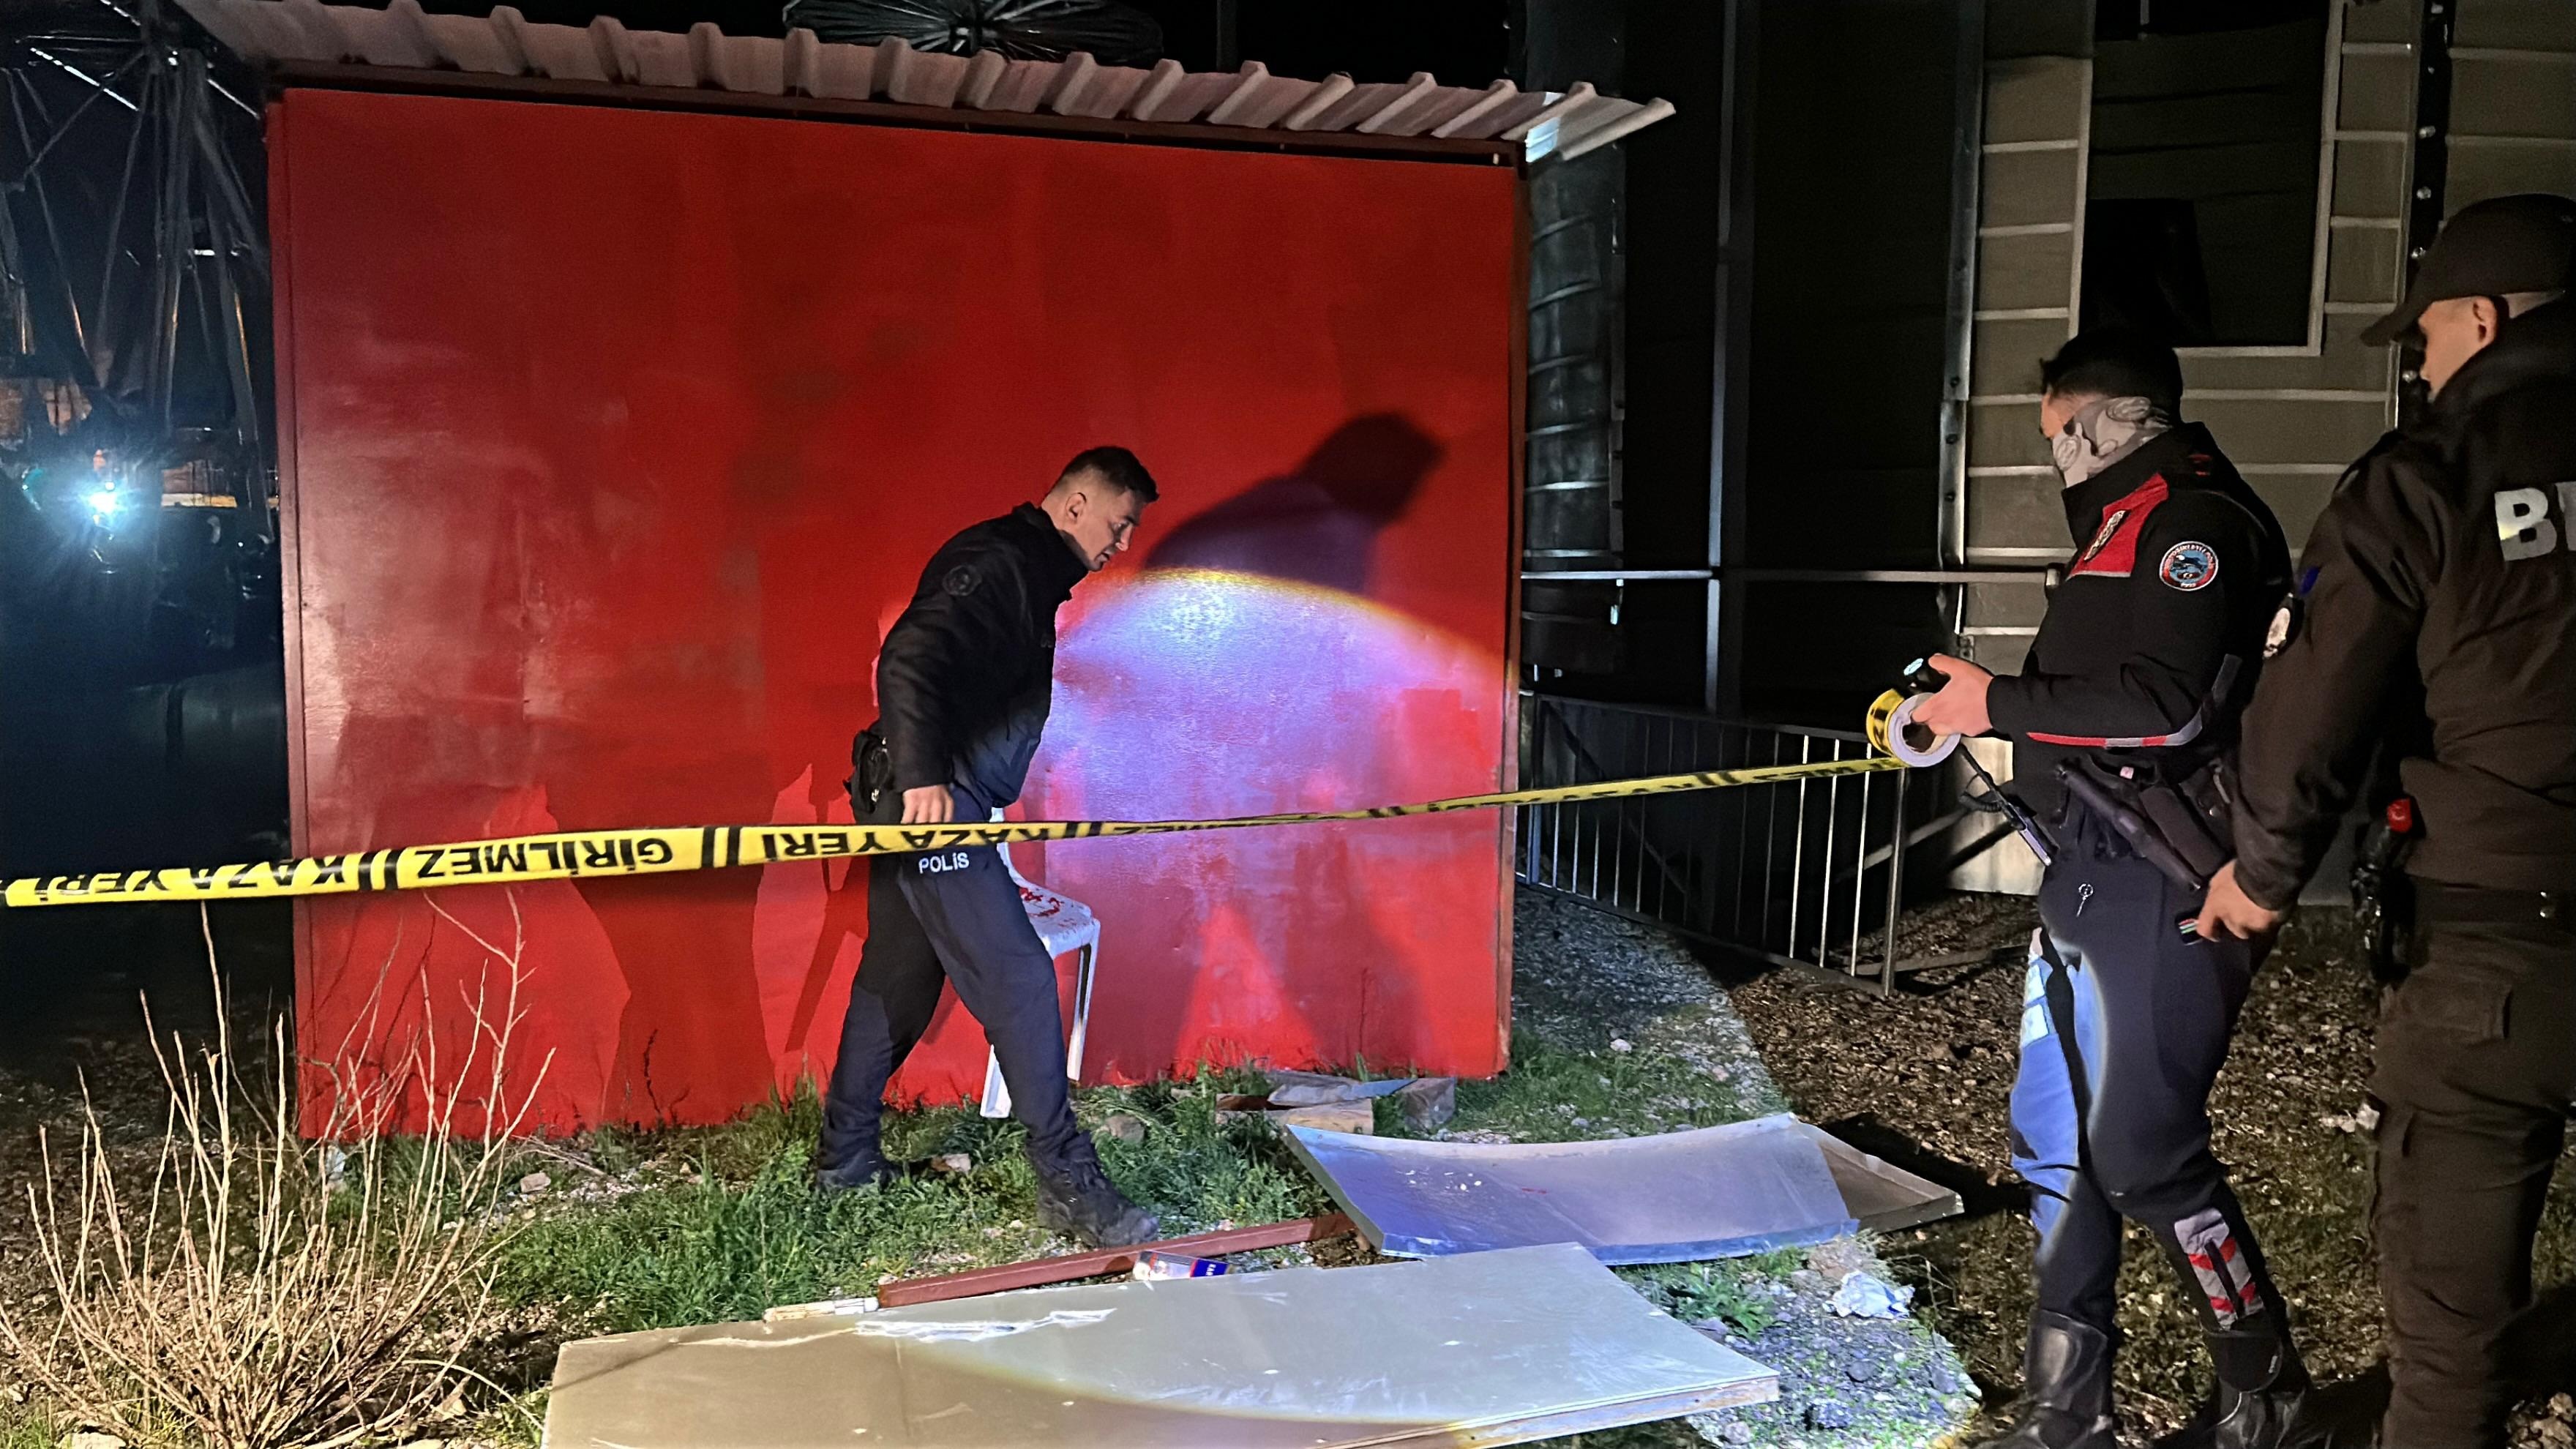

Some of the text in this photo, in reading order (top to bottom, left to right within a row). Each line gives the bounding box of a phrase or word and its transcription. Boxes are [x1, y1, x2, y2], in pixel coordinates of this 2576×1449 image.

[414, 836, 675, 879] GİRİLMEZ
[762, 831, 890, 863] YERİ
[918, 852, 970, 875] POLİS
